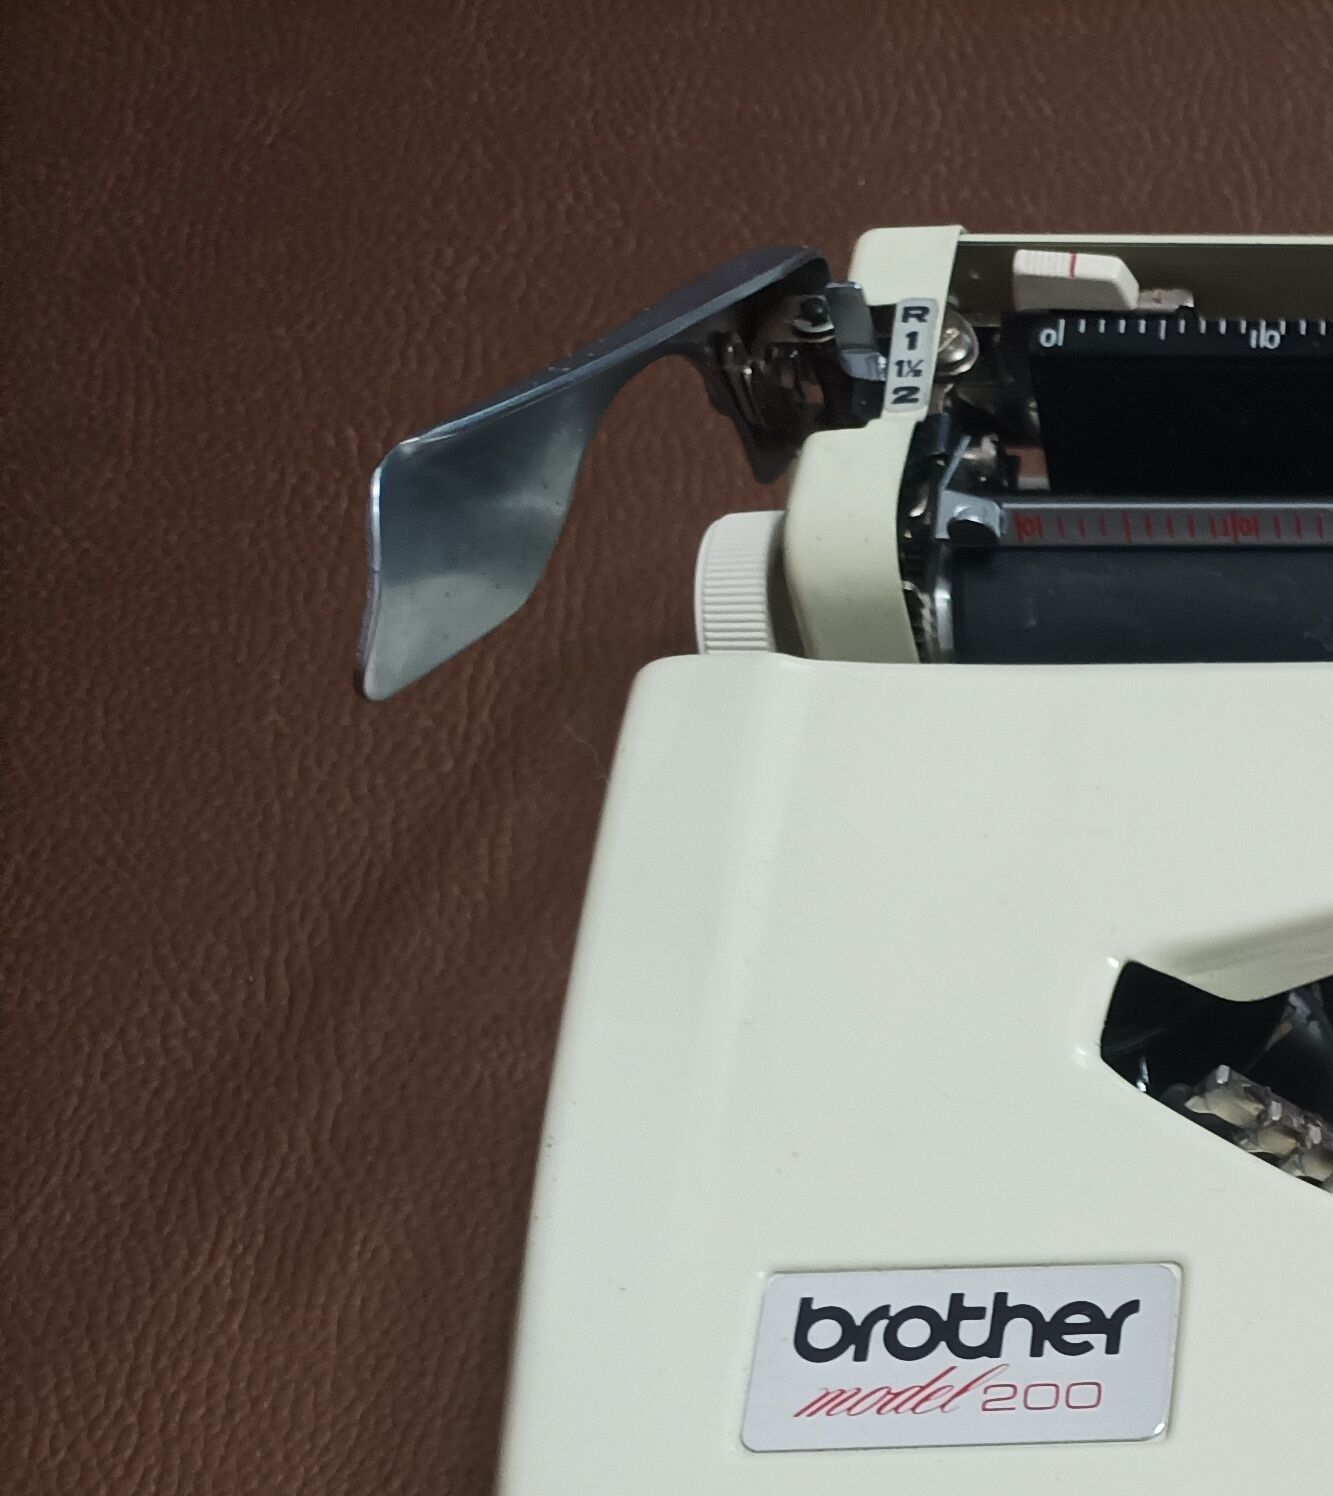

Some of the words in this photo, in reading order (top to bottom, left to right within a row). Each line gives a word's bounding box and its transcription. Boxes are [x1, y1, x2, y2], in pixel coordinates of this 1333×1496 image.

[902, 306, 930, 323] R
[905, 331, 919, 351] 1
[891, 386, 920, 405] 2
[793, 1292, 1140, 1363] brother
[794, 1364, 1010, 1417] model
[981, 1382, 1102, 1412] 200
